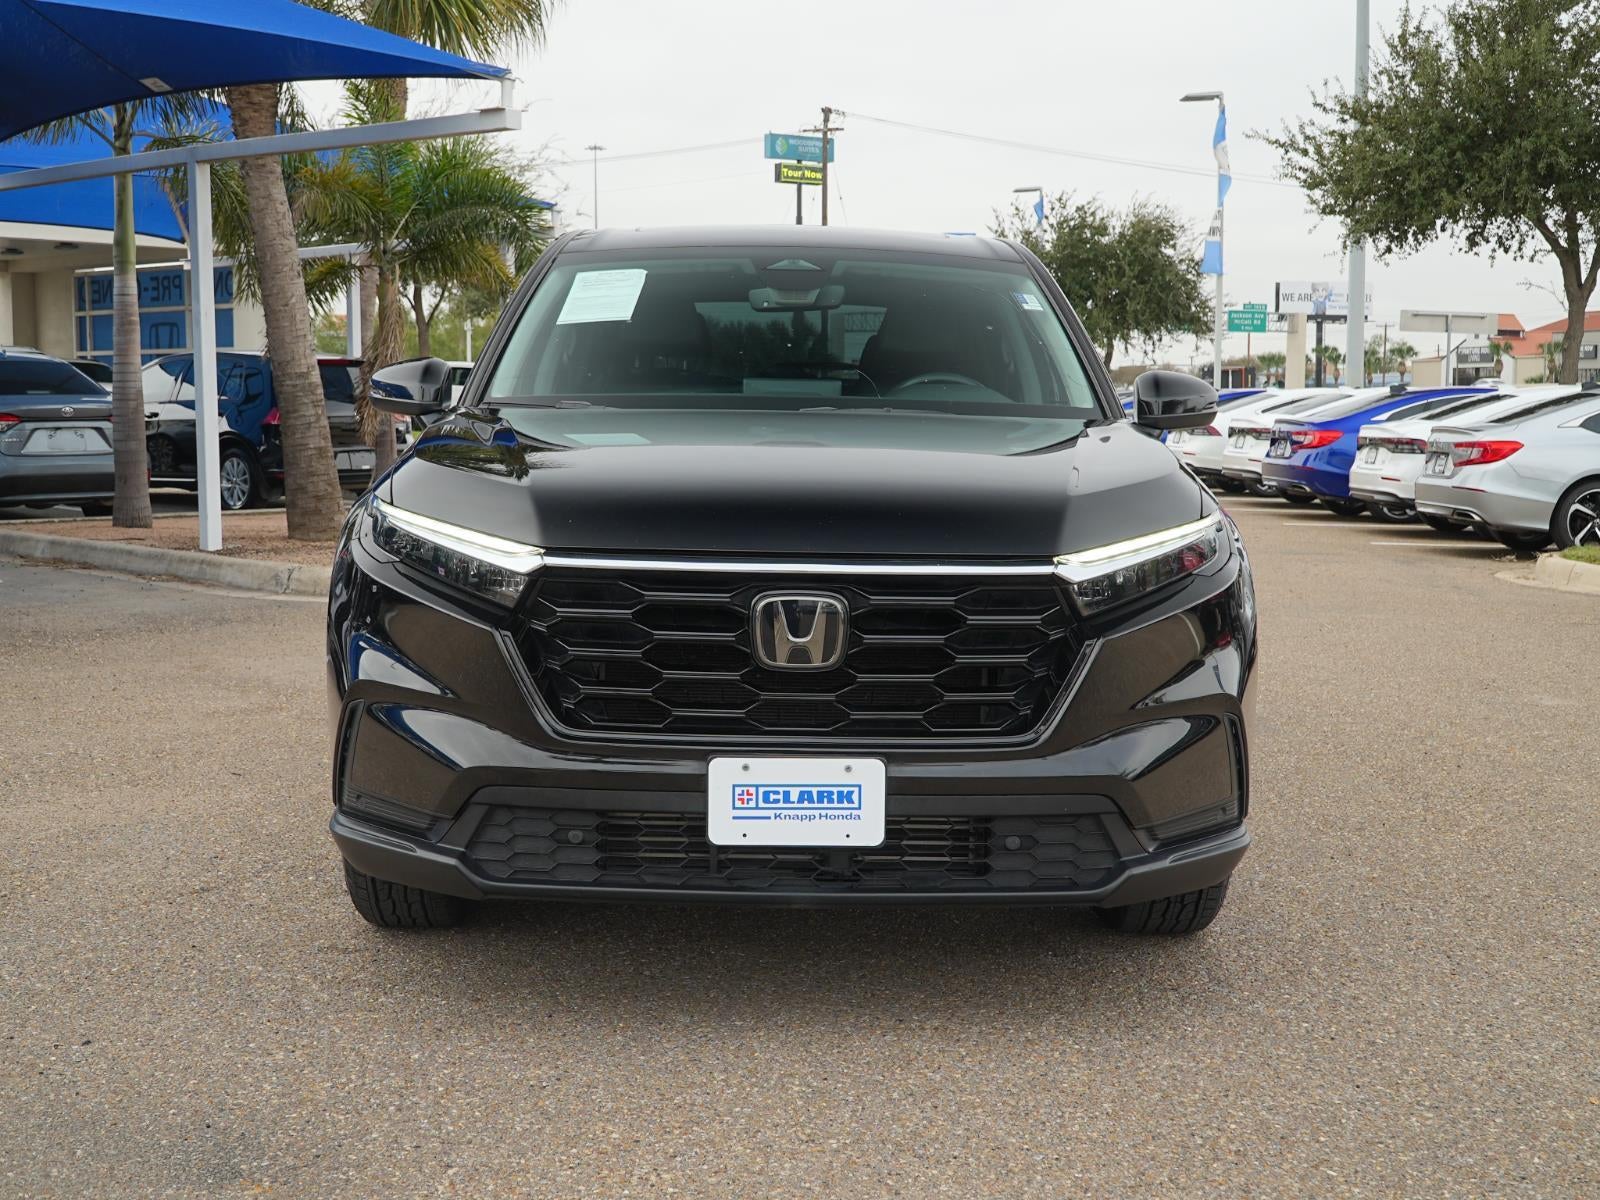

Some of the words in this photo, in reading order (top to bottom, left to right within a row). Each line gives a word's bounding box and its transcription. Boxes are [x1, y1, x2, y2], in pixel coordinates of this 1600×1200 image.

[798, 145, 820, 153] SUITES
[782, 168, 802, 177] Tour
[805, 169, 823, 179] Now
[1281, 293, 1296, 302] WE
[762, 790, 855, 805] CLARK
[774, 812, 816, 822] Knapp
[818, 812, 861, 821] Honda
